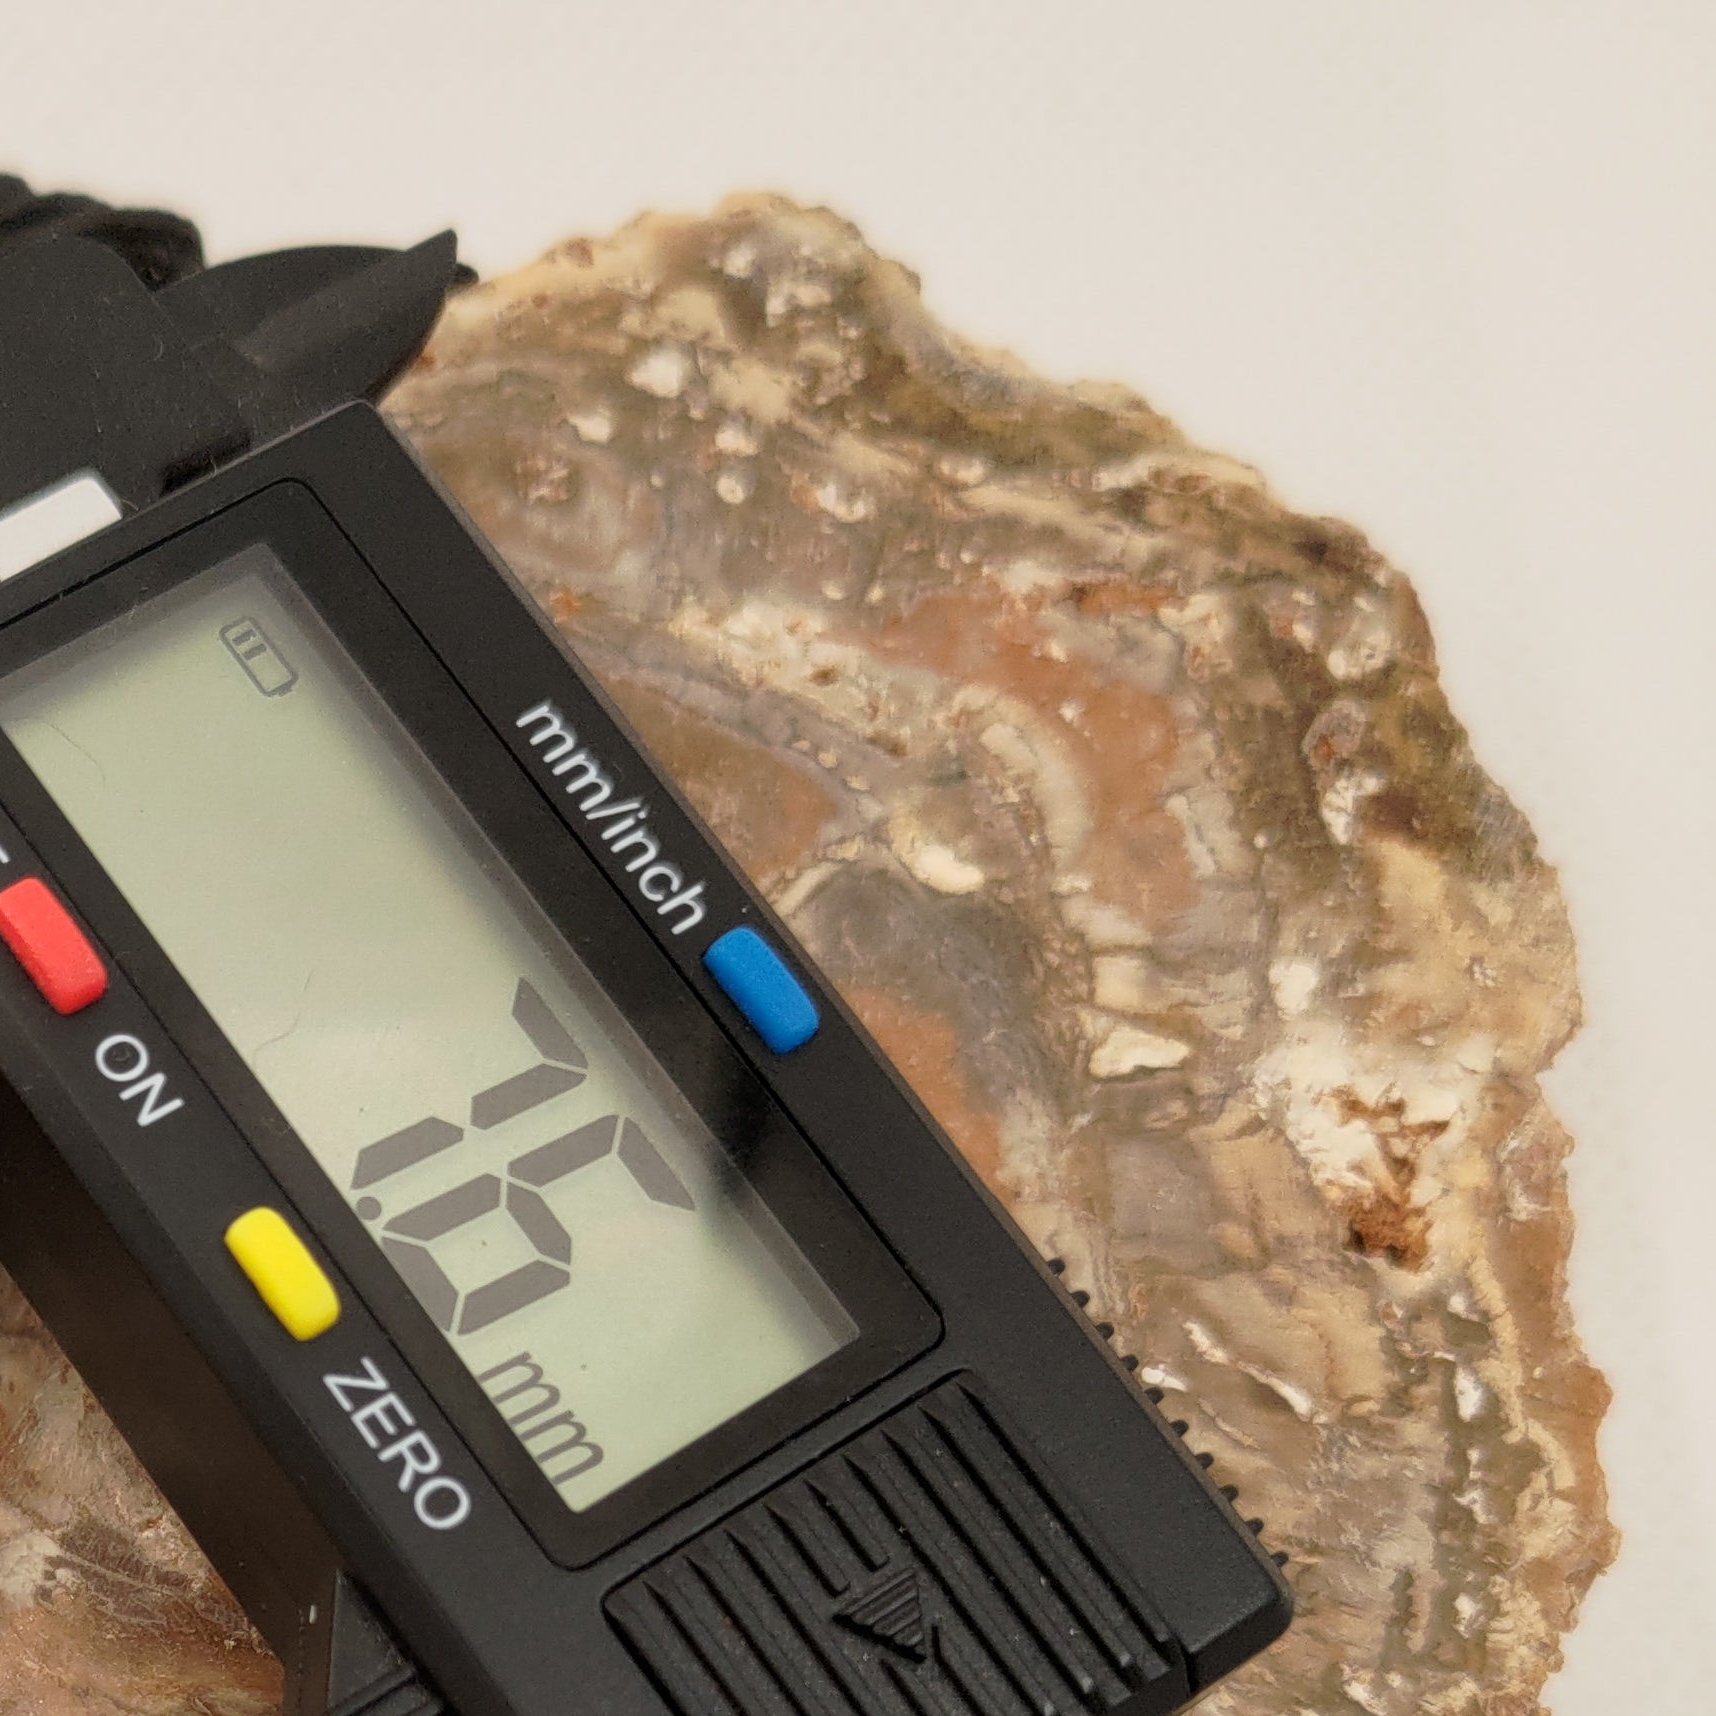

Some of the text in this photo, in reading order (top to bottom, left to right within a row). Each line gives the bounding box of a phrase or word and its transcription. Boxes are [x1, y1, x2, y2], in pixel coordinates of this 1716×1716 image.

[514, 699, 707, 935] mm/inch
[94, 1032, 184, 1127] ON
[350, 977, 696, 1486] 7.6 mm
[323, 1356, 472, 1530] ZERO
